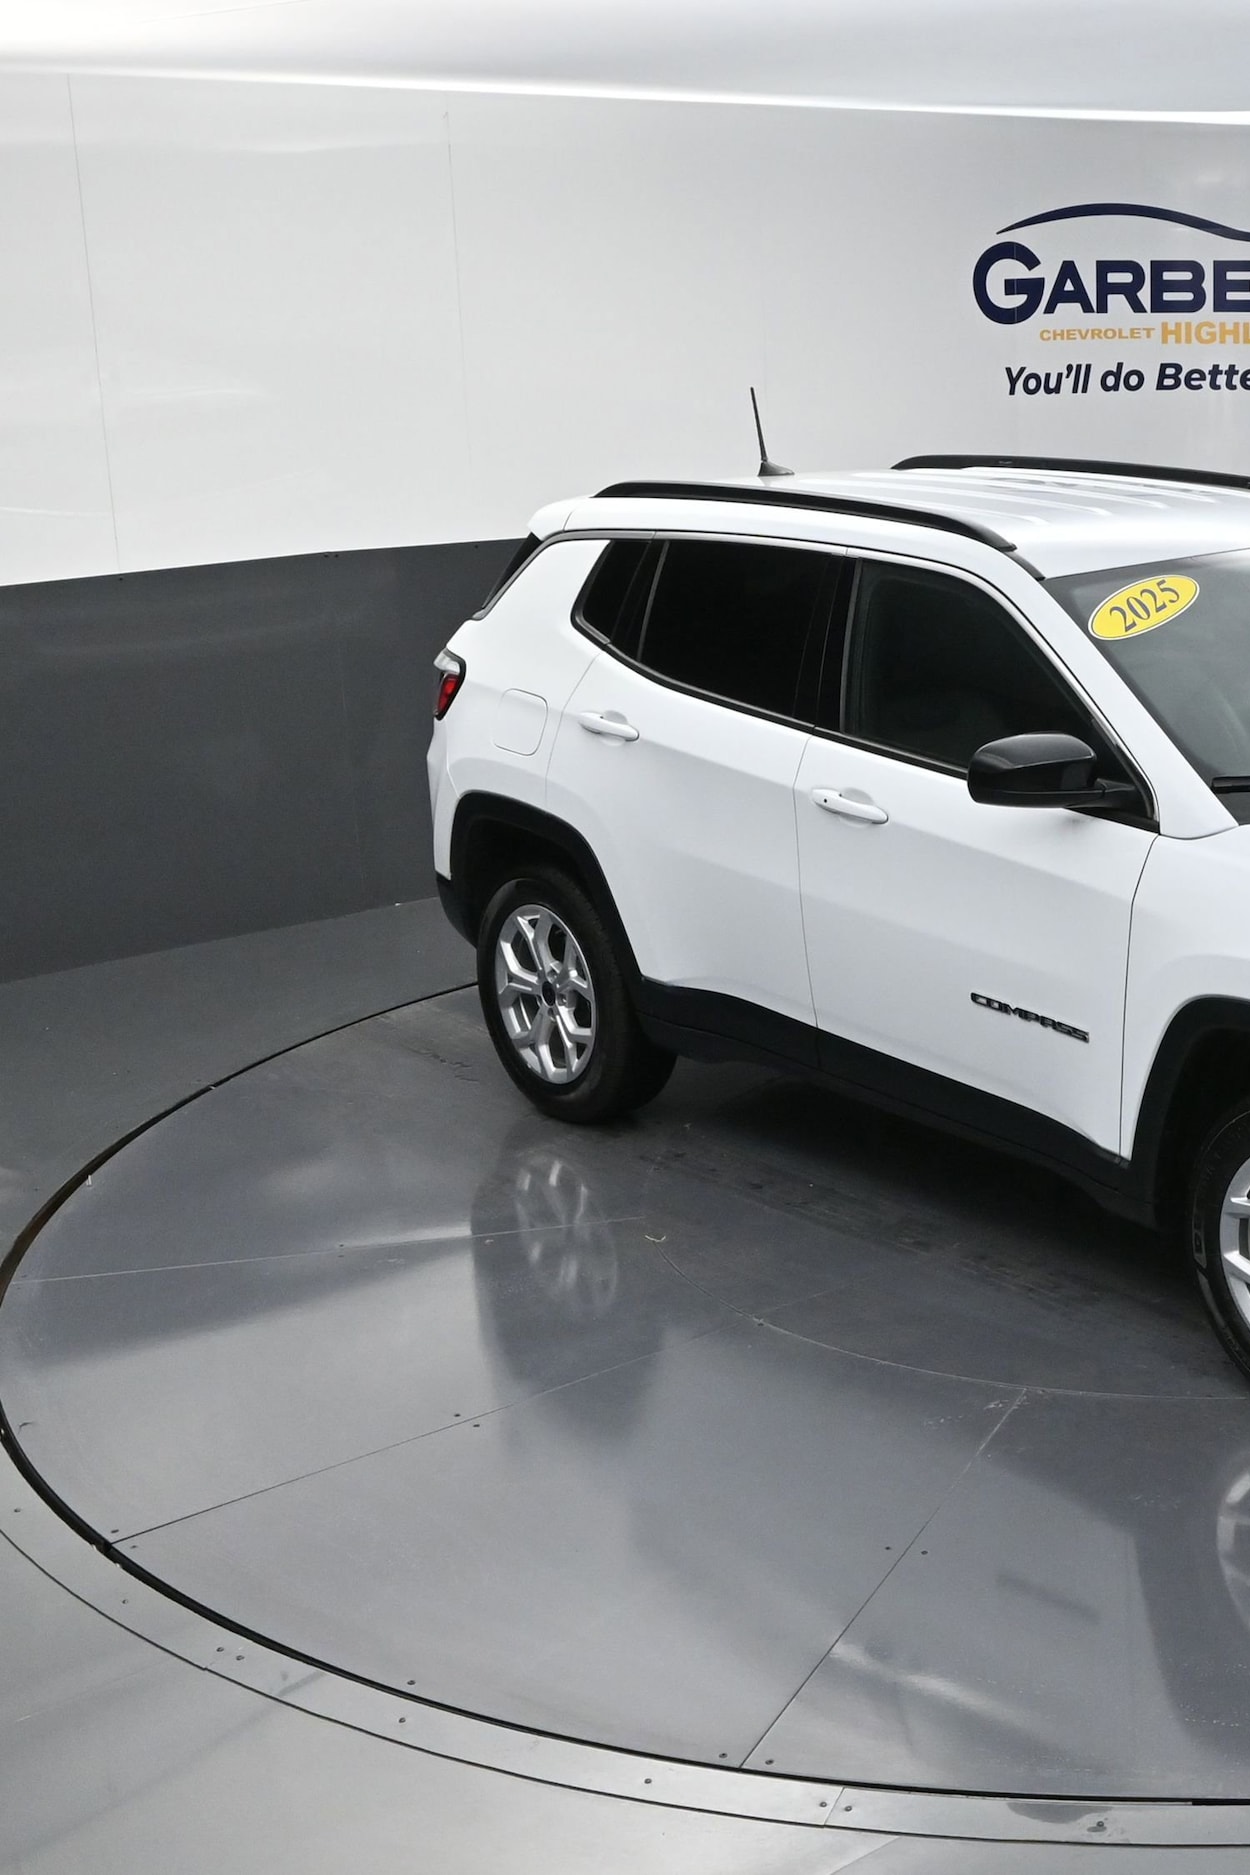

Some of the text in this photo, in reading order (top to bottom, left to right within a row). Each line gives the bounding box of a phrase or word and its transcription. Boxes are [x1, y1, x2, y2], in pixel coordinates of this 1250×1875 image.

[1040, 327, 1154, 341] CHEVROLET
[1005, 364, 1092, 395] You'll
[1100, 362, 1144, 392] do
[1109, 579, 1180, 632] 2025
[970, 992, 1090, 1043] COMPASS
